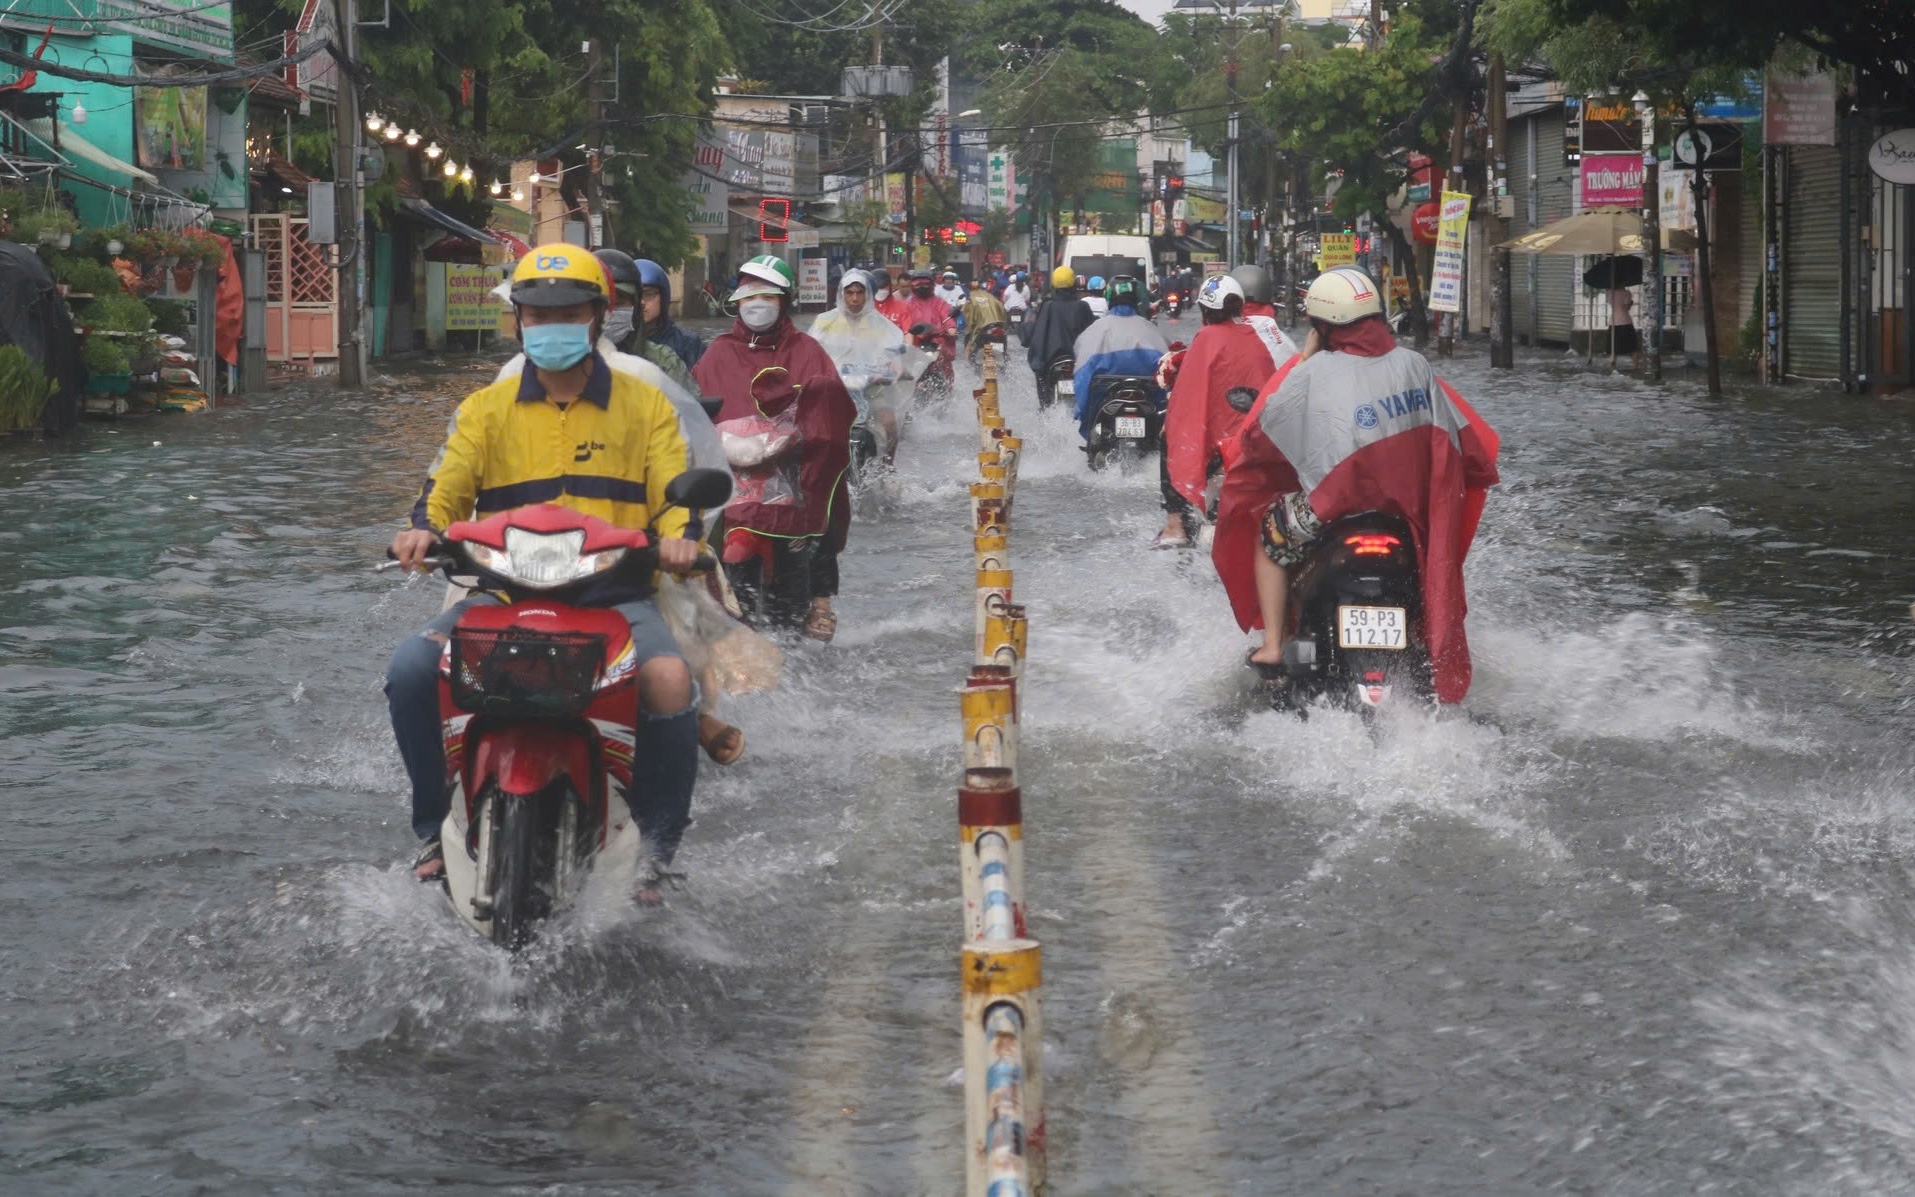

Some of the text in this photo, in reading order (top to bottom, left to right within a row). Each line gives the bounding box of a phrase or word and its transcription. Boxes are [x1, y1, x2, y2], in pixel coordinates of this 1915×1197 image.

[1323, 235, 1352, 243] LILY
[536, 253, 569, 271] be
[590, 440, 605, 450] be
[518, 609, 558, 617] HONDA
[1350, 609, 1396, 627] 59 P3
[1344, 628, 1402, 646] 112.17
